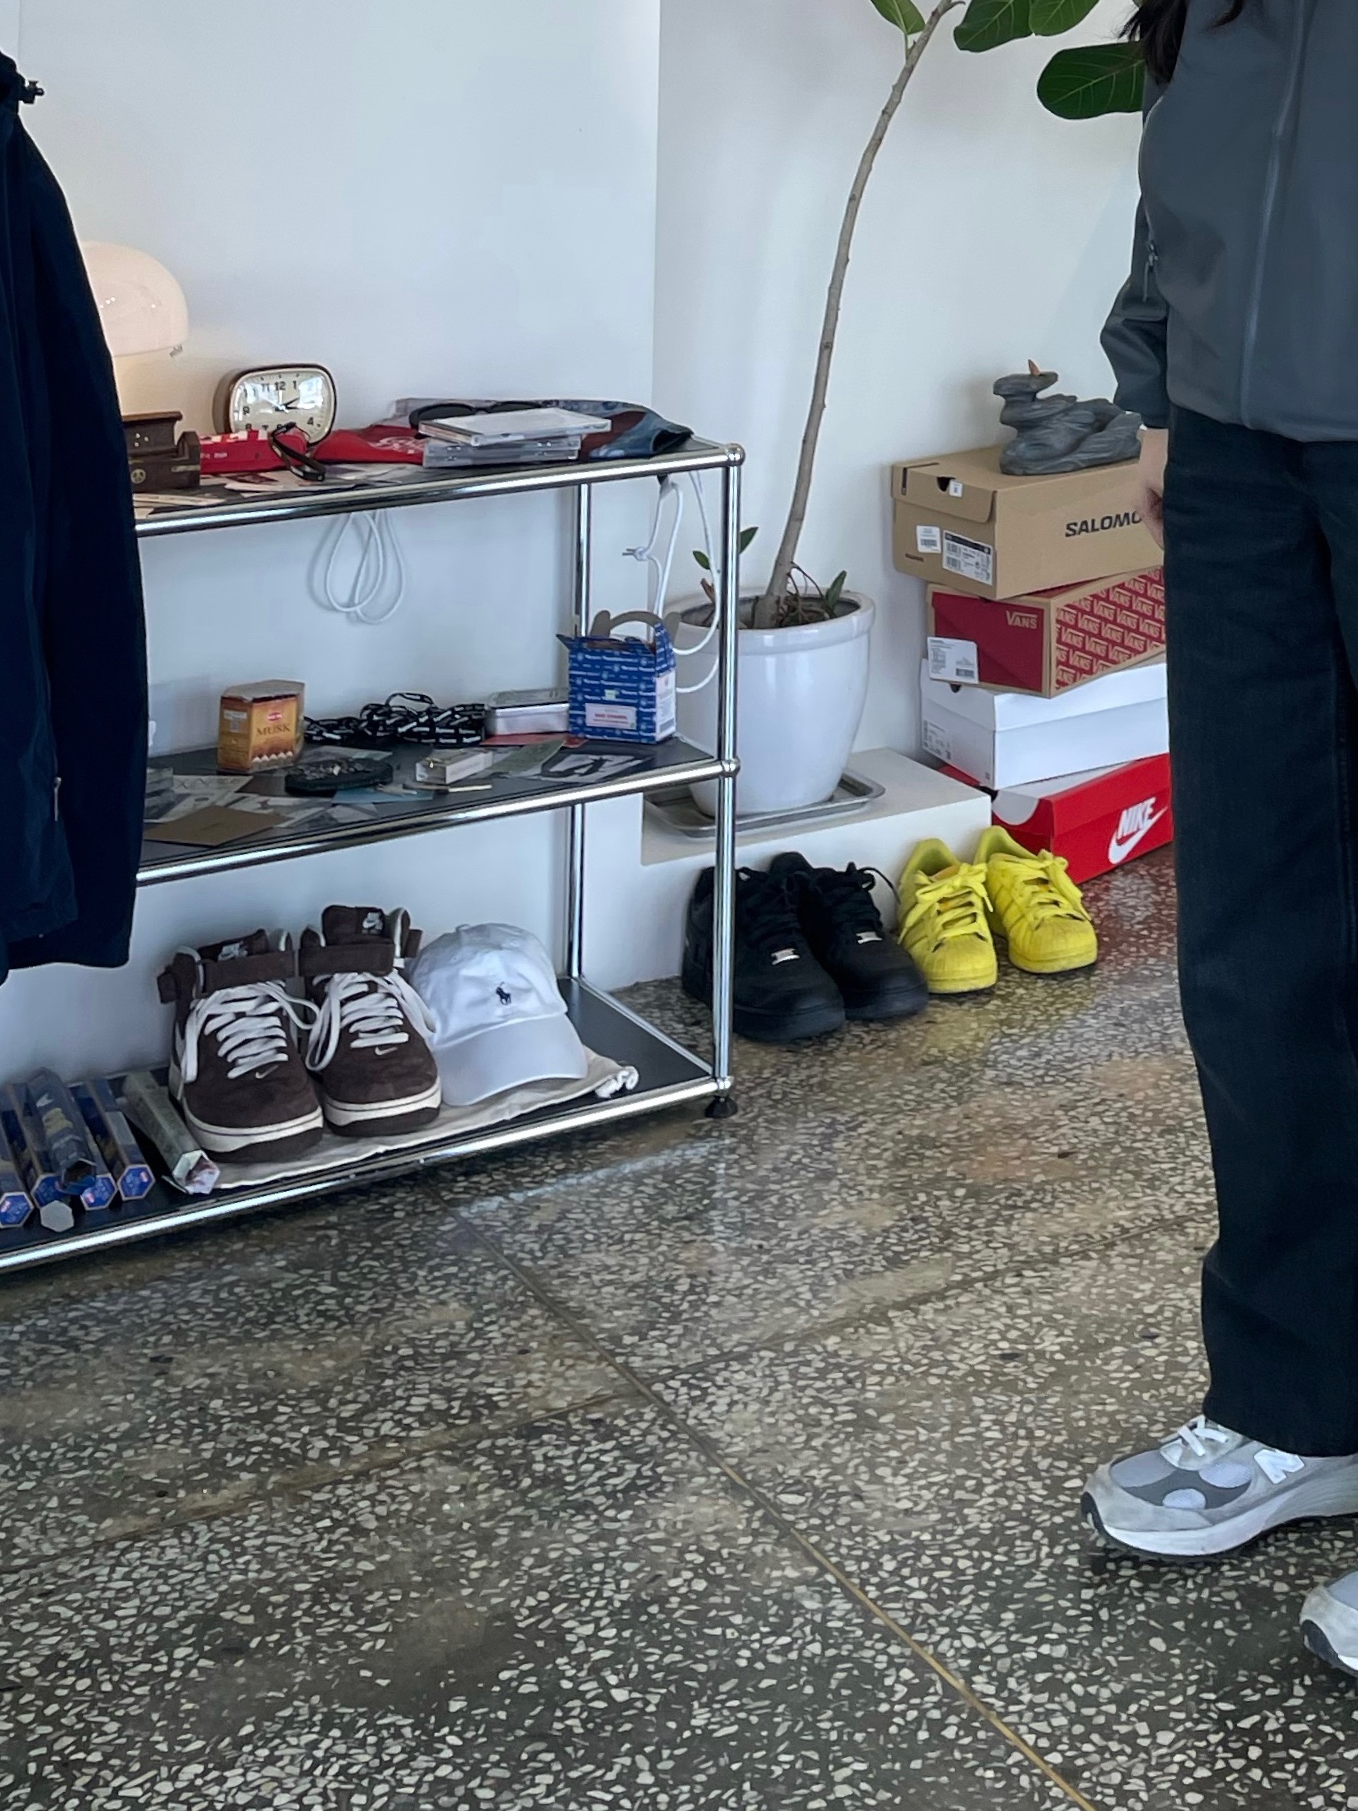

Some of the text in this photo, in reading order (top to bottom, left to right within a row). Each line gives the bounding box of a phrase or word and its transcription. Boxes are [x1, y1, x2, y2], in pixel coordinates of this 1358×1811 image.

[274, 381, 286, 391] 12
[293, 381, 298, 390] 1
[306, 417, 314, 426] 4
[1005, 610, 1038, 630] VANS
[256, 724, 291, 736] MUSK
[1117, 796, 1157, 840] NIKE
